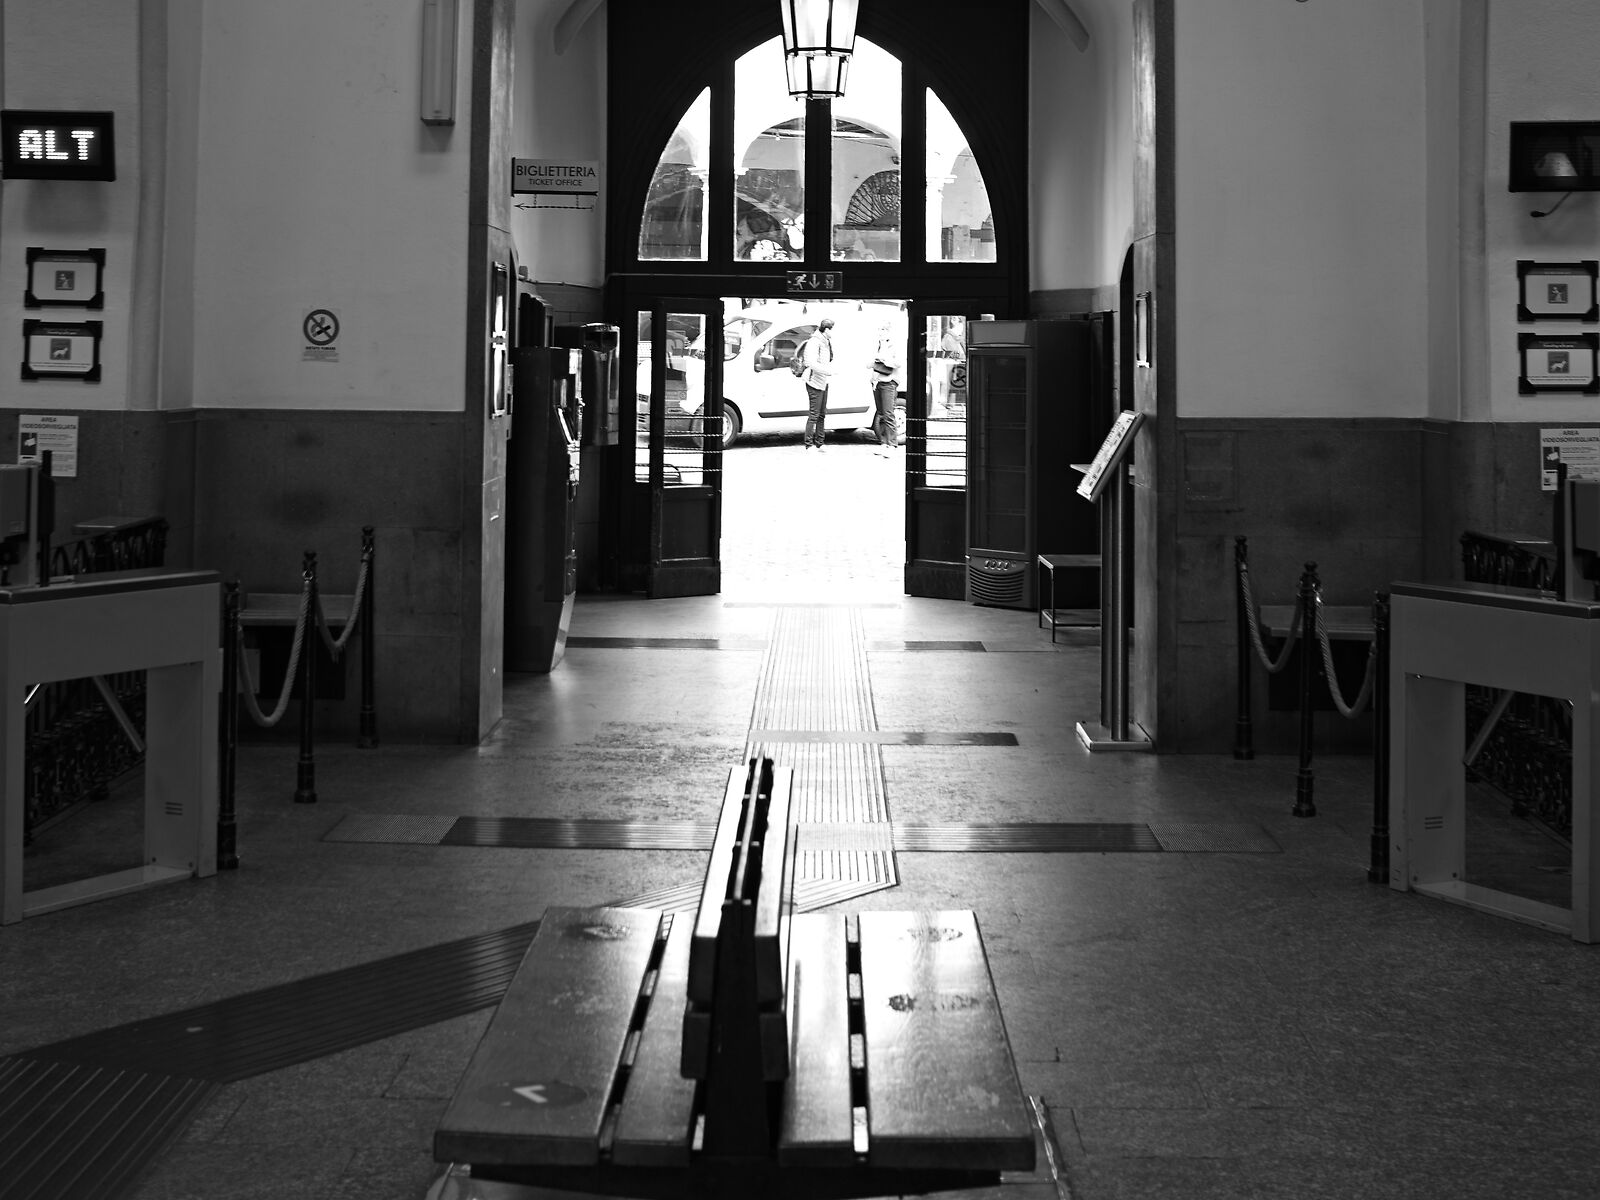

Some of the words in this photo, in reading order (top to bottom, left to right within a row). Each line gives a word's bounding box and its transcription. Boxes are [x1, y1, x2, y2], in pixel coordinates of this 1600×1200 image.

[19, 129, 95, 161] ALT
[516, 165, 596, 177] BIGLIETTERIA
[529, 178, 554, 186] TICKET
